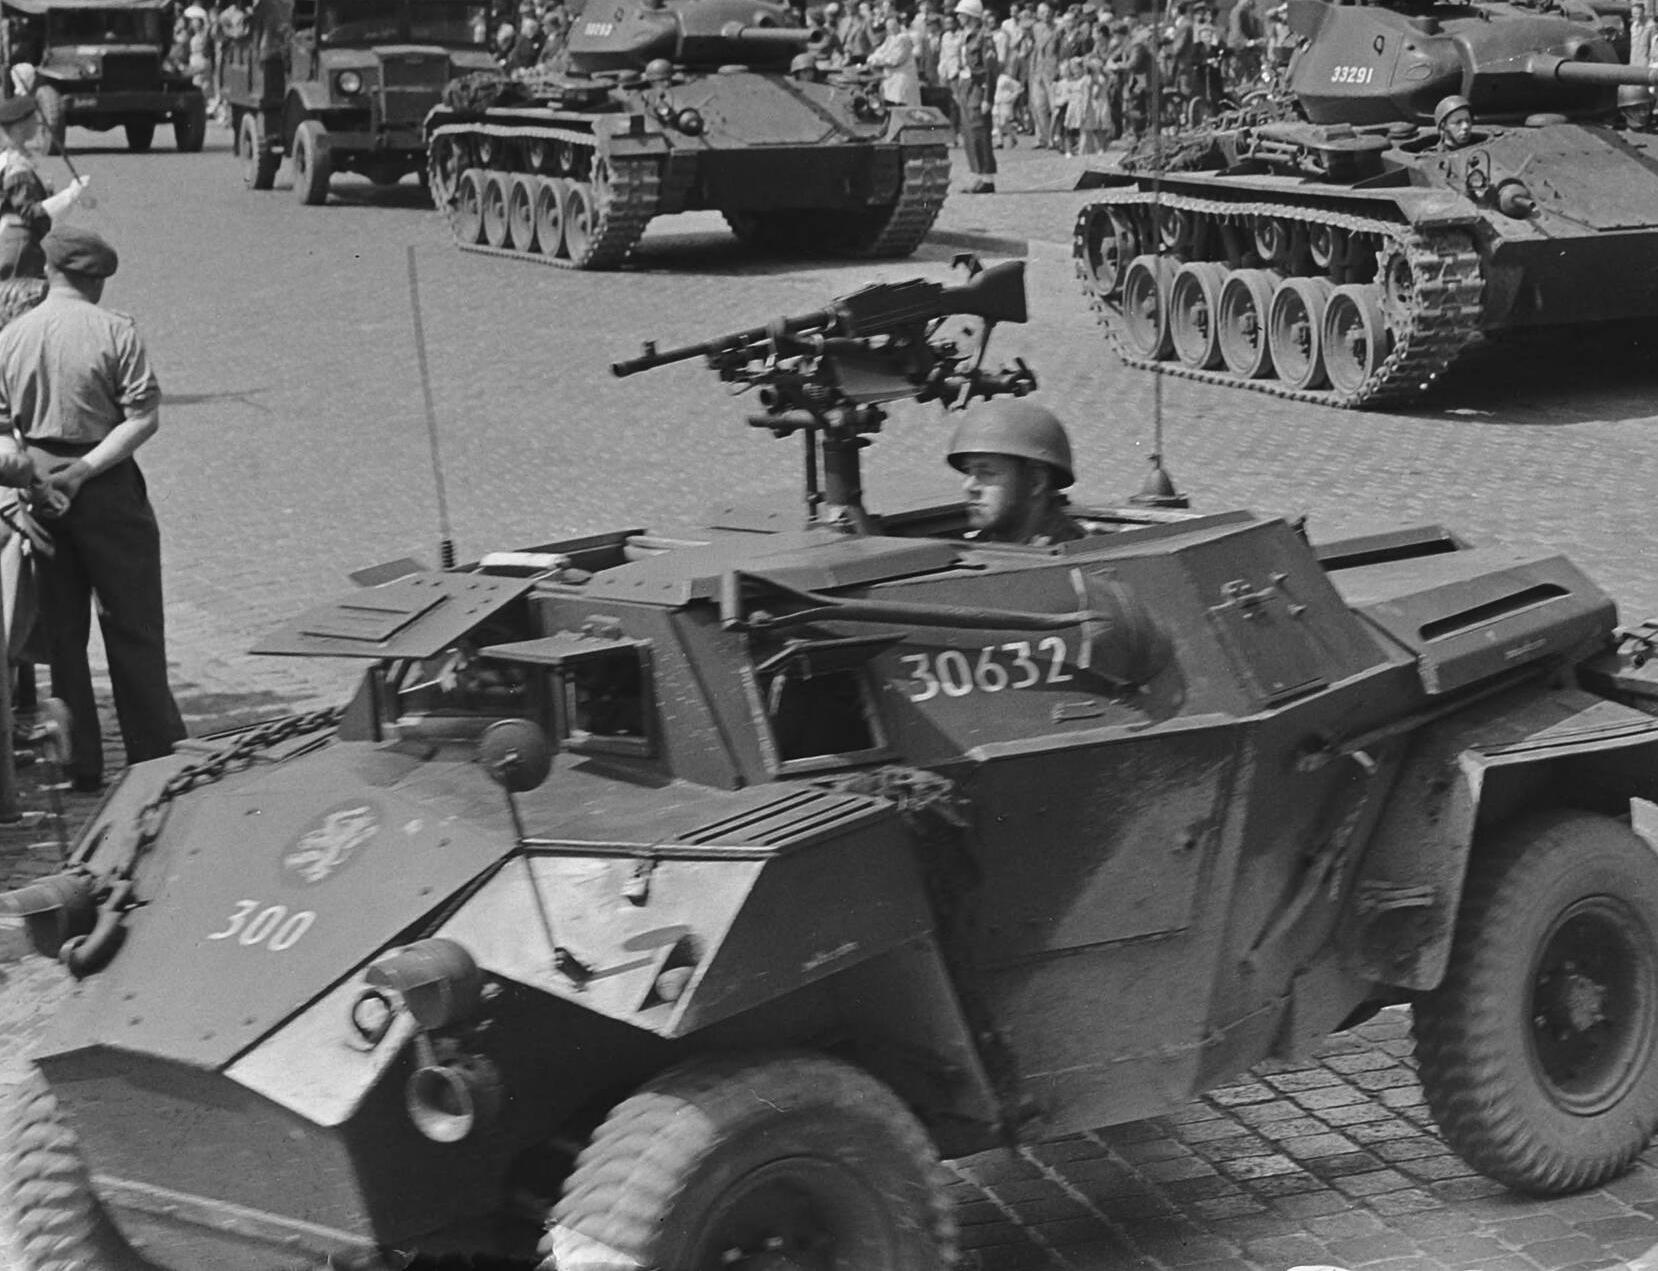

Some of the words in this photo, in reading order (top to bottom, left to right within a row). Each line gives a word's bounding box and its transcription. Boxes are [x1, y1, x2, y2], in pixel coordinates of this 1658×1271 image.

[1331, 65, 1374, 84] 33291
[900, 636, 1074, 703] 30632
[206, 899, 317, 951] 300
